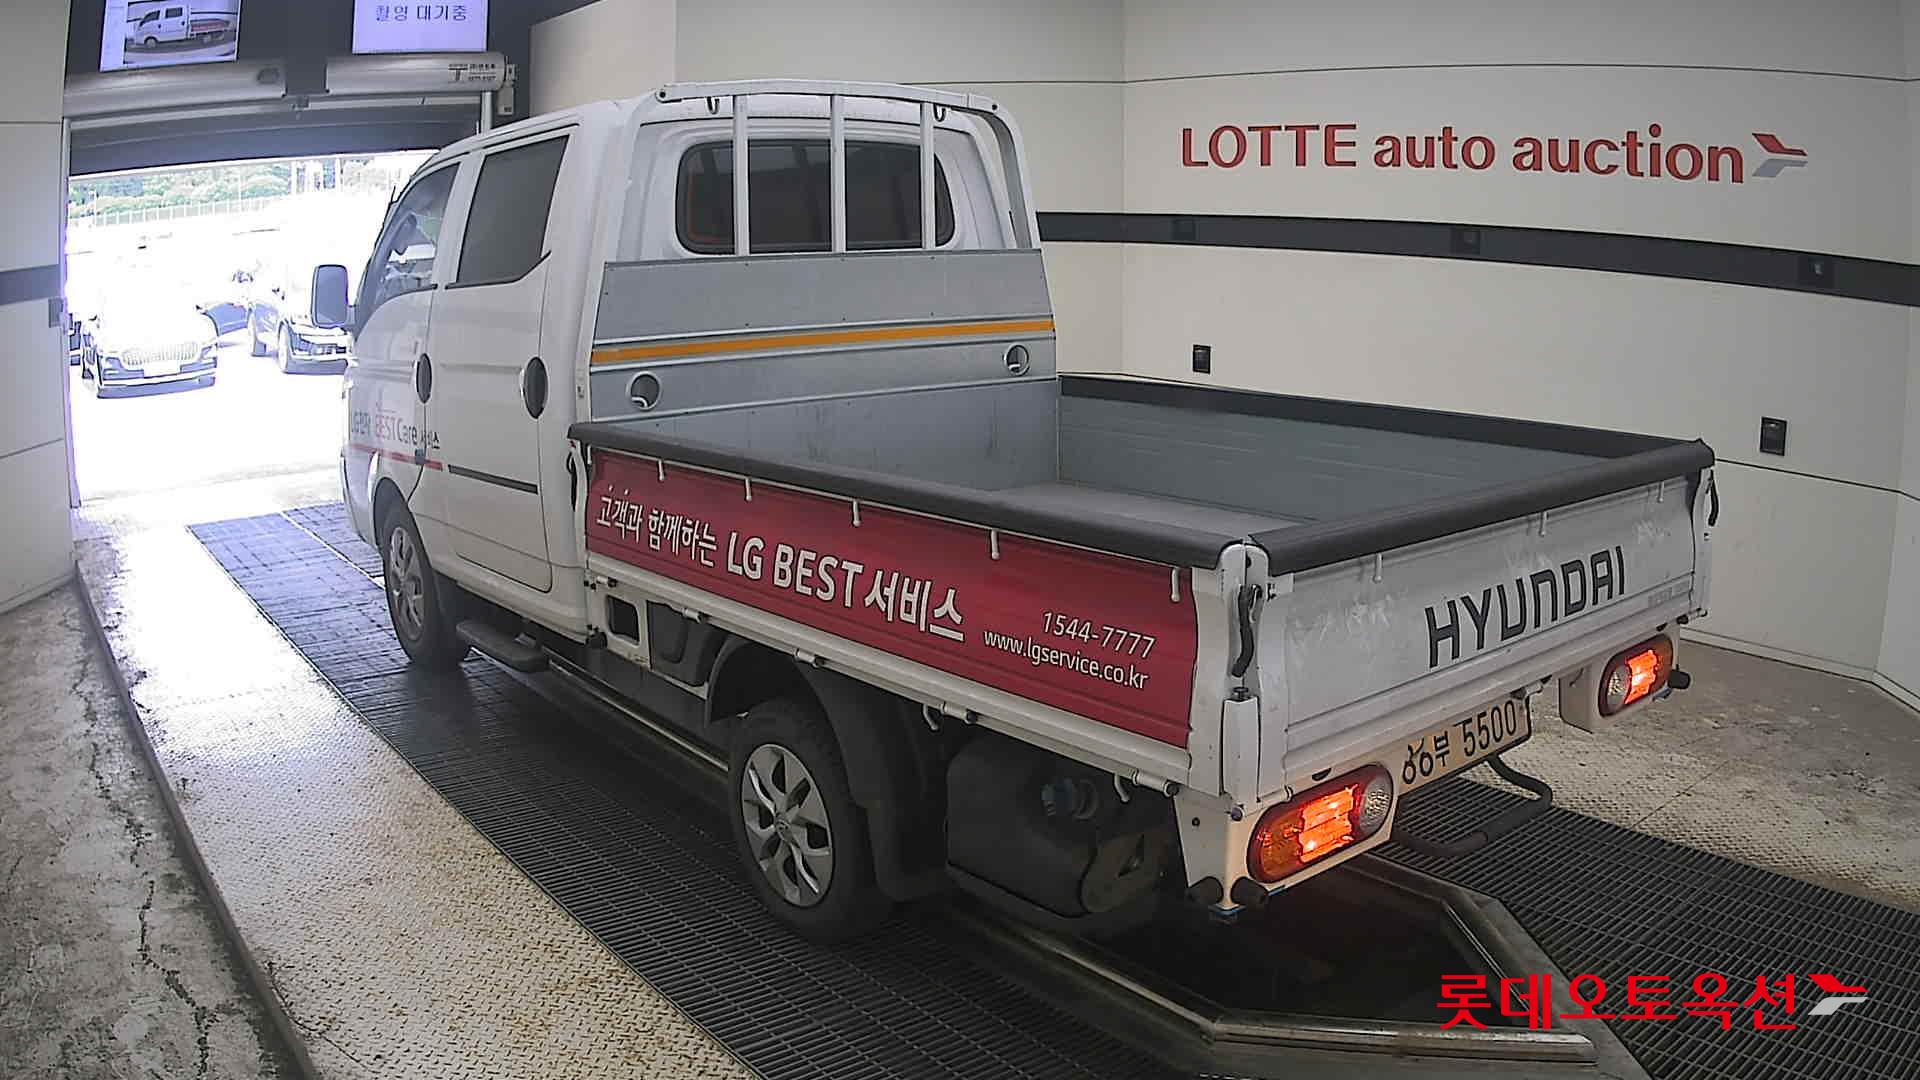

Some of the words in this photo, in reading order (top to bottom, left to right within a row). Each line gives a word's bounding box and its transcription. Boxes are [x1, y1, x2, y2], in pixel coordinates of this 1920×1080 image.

[416, 5, 467, 21] 대기중
[1182, 123, 1357, 168] LOTTE
[1373, 126, 1496, 170] auto
[1512, 123, 1744, 183] auction
[596, 484, 643, 543] 고객과
[649, 509, 718, 568] 함께하는
[727, 531, 765, 580] LG
[773, 543, 864, 607] BEST
[864, 570, 964, 642] 서비스
[1042, 612, 1156, 659] 1544-7777
[1424, 546, 1625, 668] HYUNDAI
[983, 630, 1149, 690] www.lgservice.co.kr
[1454, 700, 1517, 757] 5500
